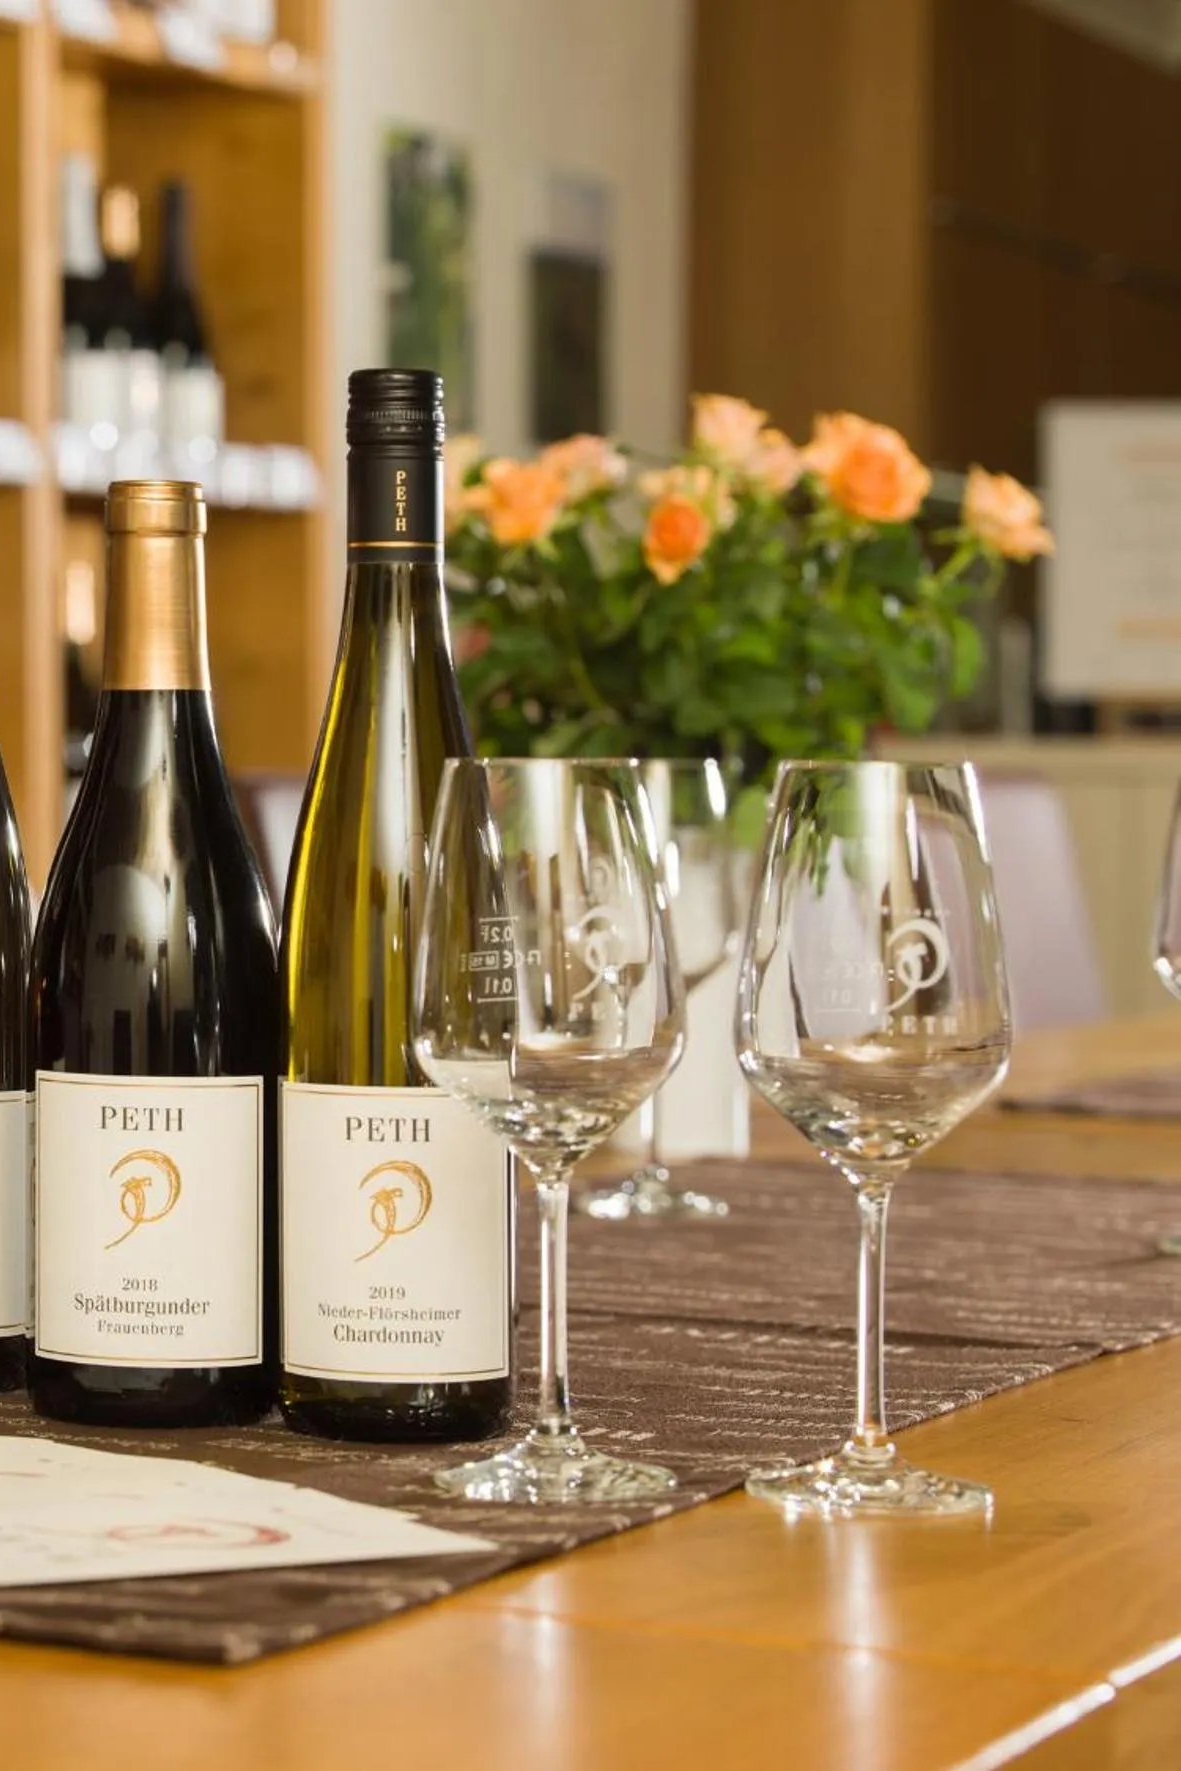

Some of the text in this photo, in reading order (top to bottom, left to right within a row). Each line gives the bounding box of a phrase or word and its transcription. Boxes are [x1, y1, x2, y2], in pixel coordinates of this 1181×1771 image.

[395, 470, 407, 532] PETH
[100, 1105, 185, 1133] PETH
[345, 1116, 432, 1144] PETH
[122, 1277, 159, 1292] 2018
[368, 1286, 407, 1301] 2019
[74, 1292, 211, 1318] Spätburgunder
[318, 1301, 463, 1321] Nieder-Flörsheimer
[97, 1319, 185, 1337] Frauenberg
[333, 1323, 446, 1347] Chardonnay
